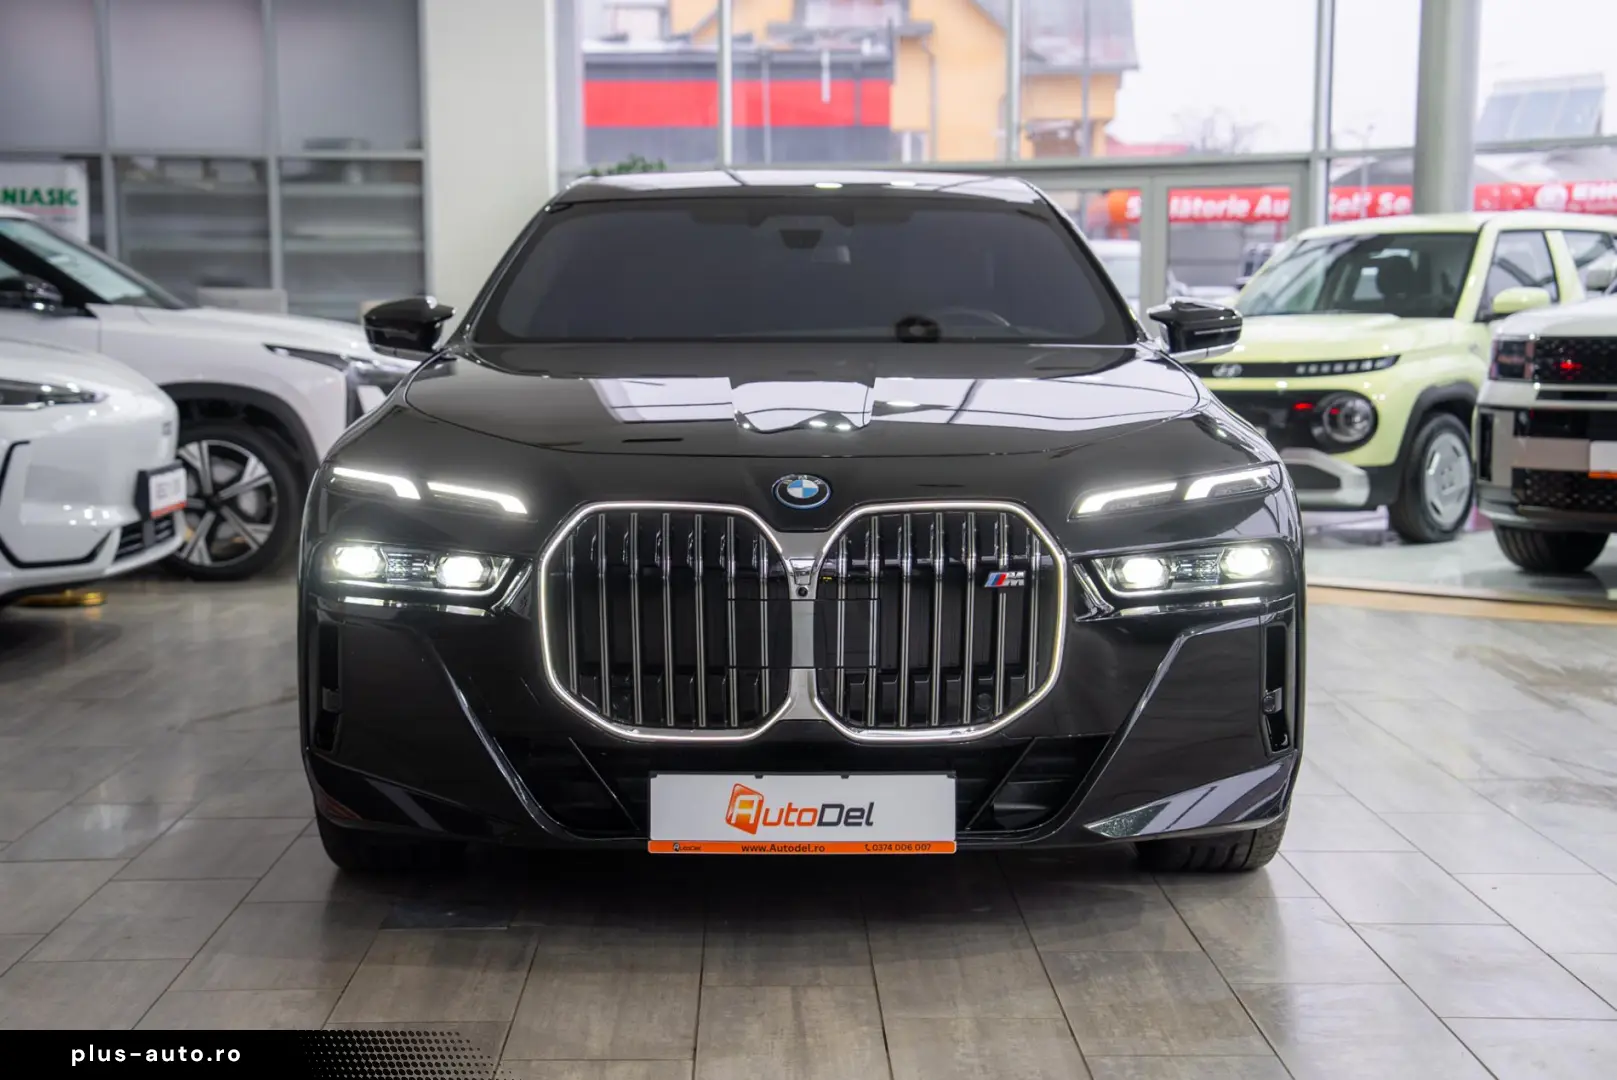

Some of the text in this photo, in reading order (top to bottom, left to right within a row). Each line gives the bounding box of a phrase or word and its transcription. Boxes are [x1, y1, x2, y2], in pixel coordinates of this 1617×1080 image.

[0, 187, 79, 206] NIASIG
[725, 783, 875, 834] AutoDel
[741, 843, 825, 853] www.Autodel.ro
[872, 843, 892, 852] 0374
